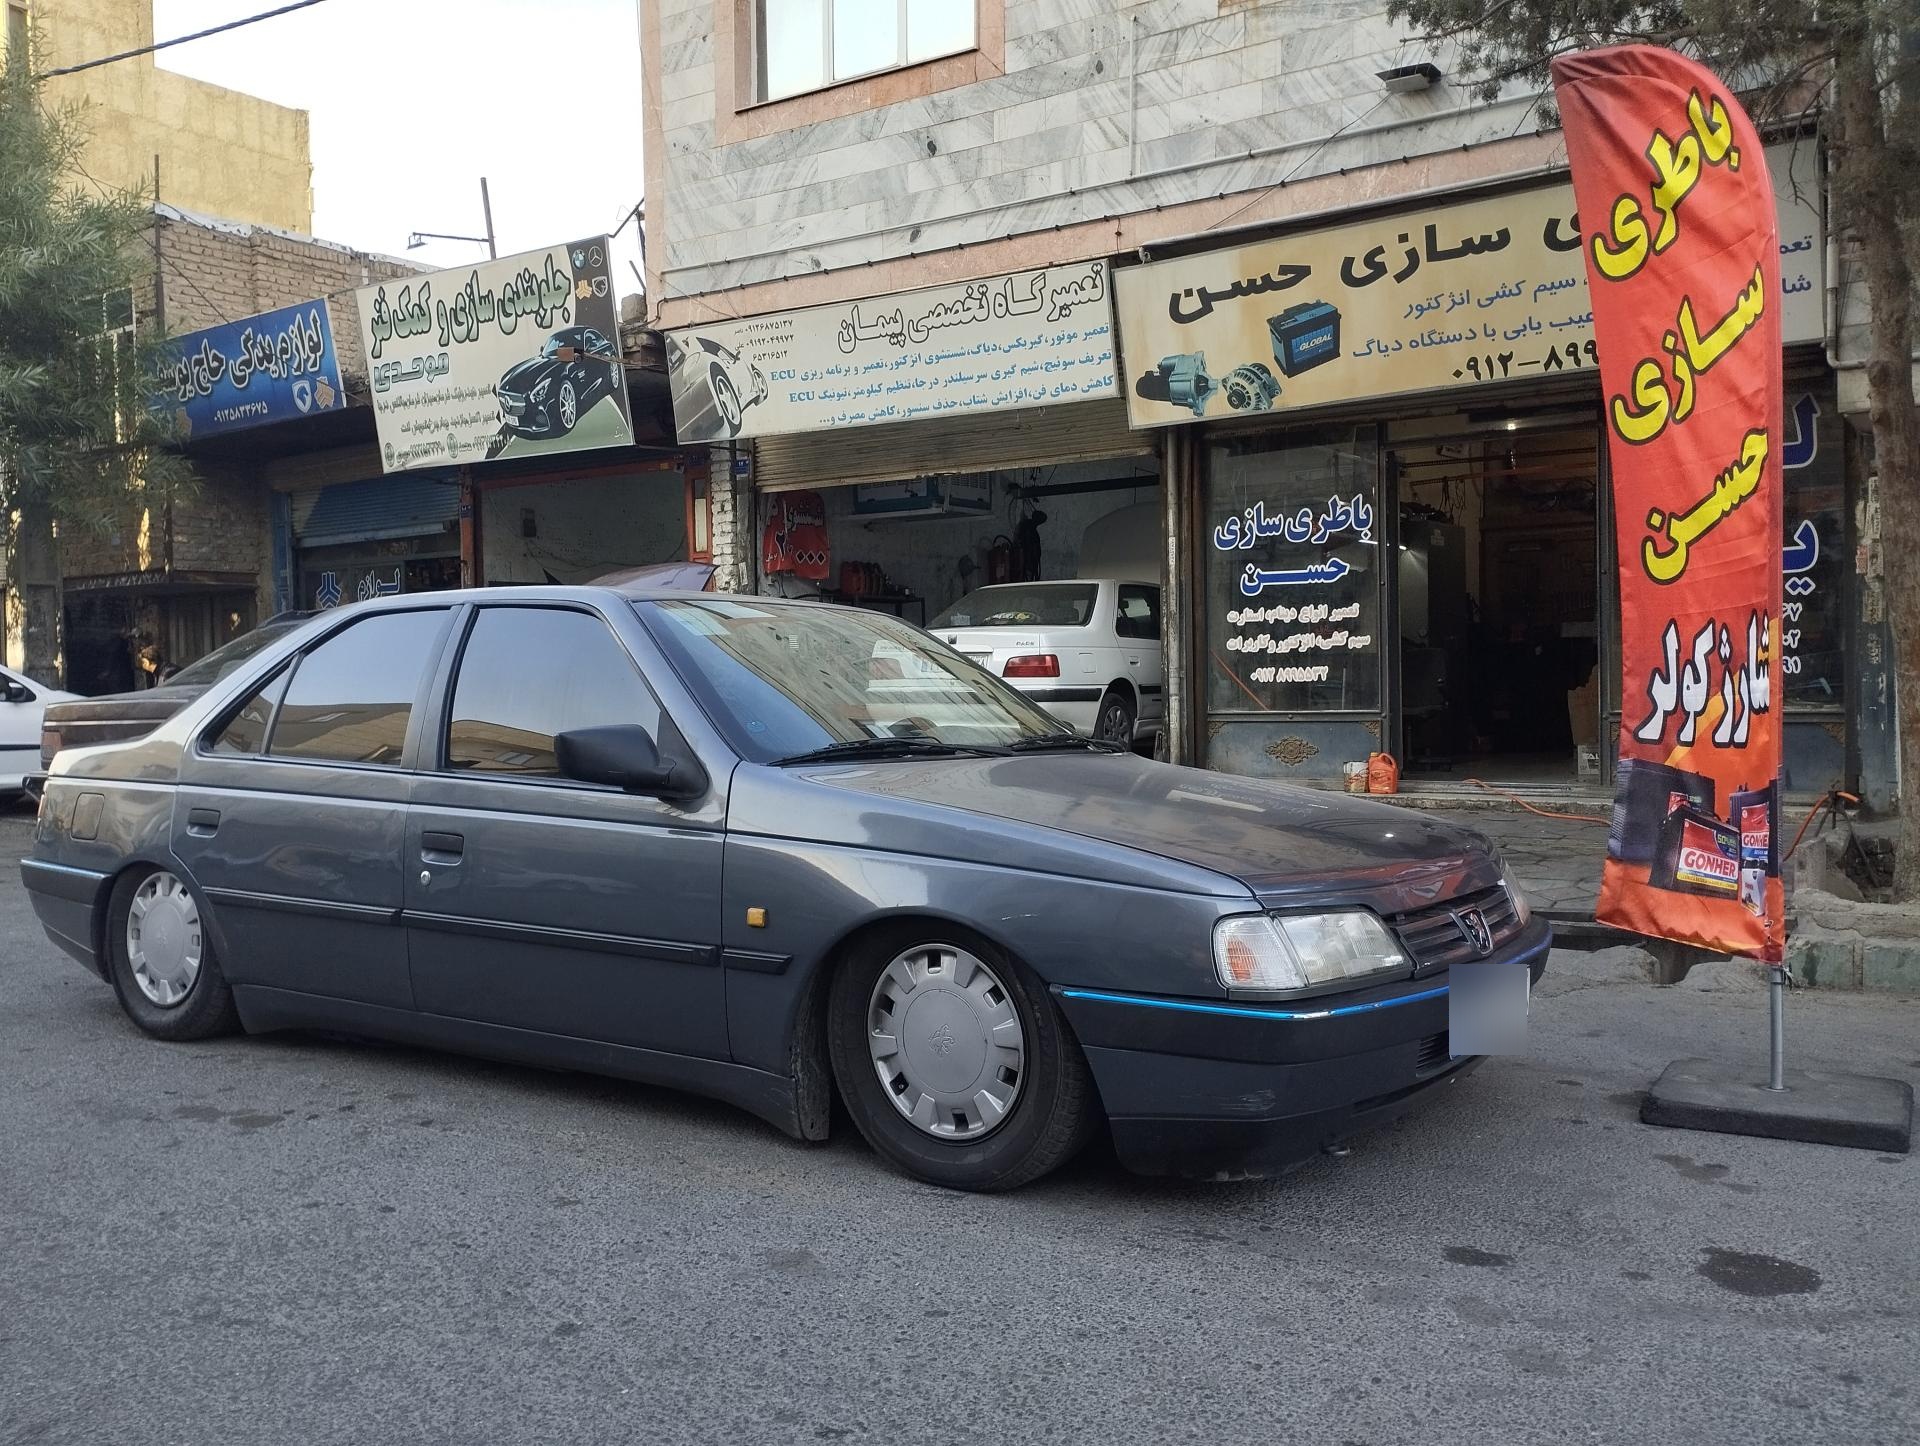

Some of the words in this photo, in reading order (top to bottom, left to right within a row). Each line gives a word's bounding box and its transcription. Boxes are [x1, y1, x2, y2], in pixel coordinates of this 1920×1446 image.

[1591, 87, 1740, 282] باطری
[1340, 223, 1511, 288] سازی
[498, 253, 571, 336] جلوبندی
[1168, 261, 1311, 324] حسن
[1403, 289, 1471, 319] انژکتور
[1477, 280, 1526, 309] کشی
[1533, 277, 1576, 303] سیم
[393, 281, 431, 339] کمک
[450, 269, 495, 343] سازی
[908, 284, 991, 344] تخصصی
[371, 286, 392, 358] فنر
[437, 299, 449, 347] و
[838, 304, 906, 354] پیمان
[1083, 322, 1110, 342] تعمیر
[1483, 323, 1497, 342] با
[1503, 316, 1542, 341] یابی
[276, 308, 324, 379] لوازم
[1300, 333, 1333, 351] GLOBAL
[1353, 338, 1403, 358] دیاگ
[1409, 327, 1477, 350] دستگاه
[1610, 260, 1765, 446] سازی
[192, 338, 226, 396] حاج
[229, 326, 277, 389] یدکی
[825, 363, 851, 377] برنامه
[1020, 360, 1040, 377] شیم
[1078, 349, 1112, 366] تعریف
[374, 353, 450, 394] موحدی
[770, 369, 797, 381] ECU
[800, 369, 824, 382] ریزی
[886, 380, 911, 396] تنظیم
[1081, 374, 1115, 394] کاهش
[789, 391, 815, 402] ECU
[933, 398, 958, 411] حذف
[991, 387, 1028, 406] افزایش
[1050, 382, 1078, 398] دمای
[837, 411, 866, 424] مصرف
[868, 405, 896, 421] کاهش
[1285, 493, 1373, 544] باطری
[1642, 426, 1768, 585] حسن
[1214, 501, 1285, 550] سازی
[358, 568, 400, 602] لوازم
[1240, 557, 1350, 596] حسن
[1633, 618, 1715, 747] کولر
[1712, 609, 1770, 748] شارژ
[1683, 850, 1737, 879] GONHER
